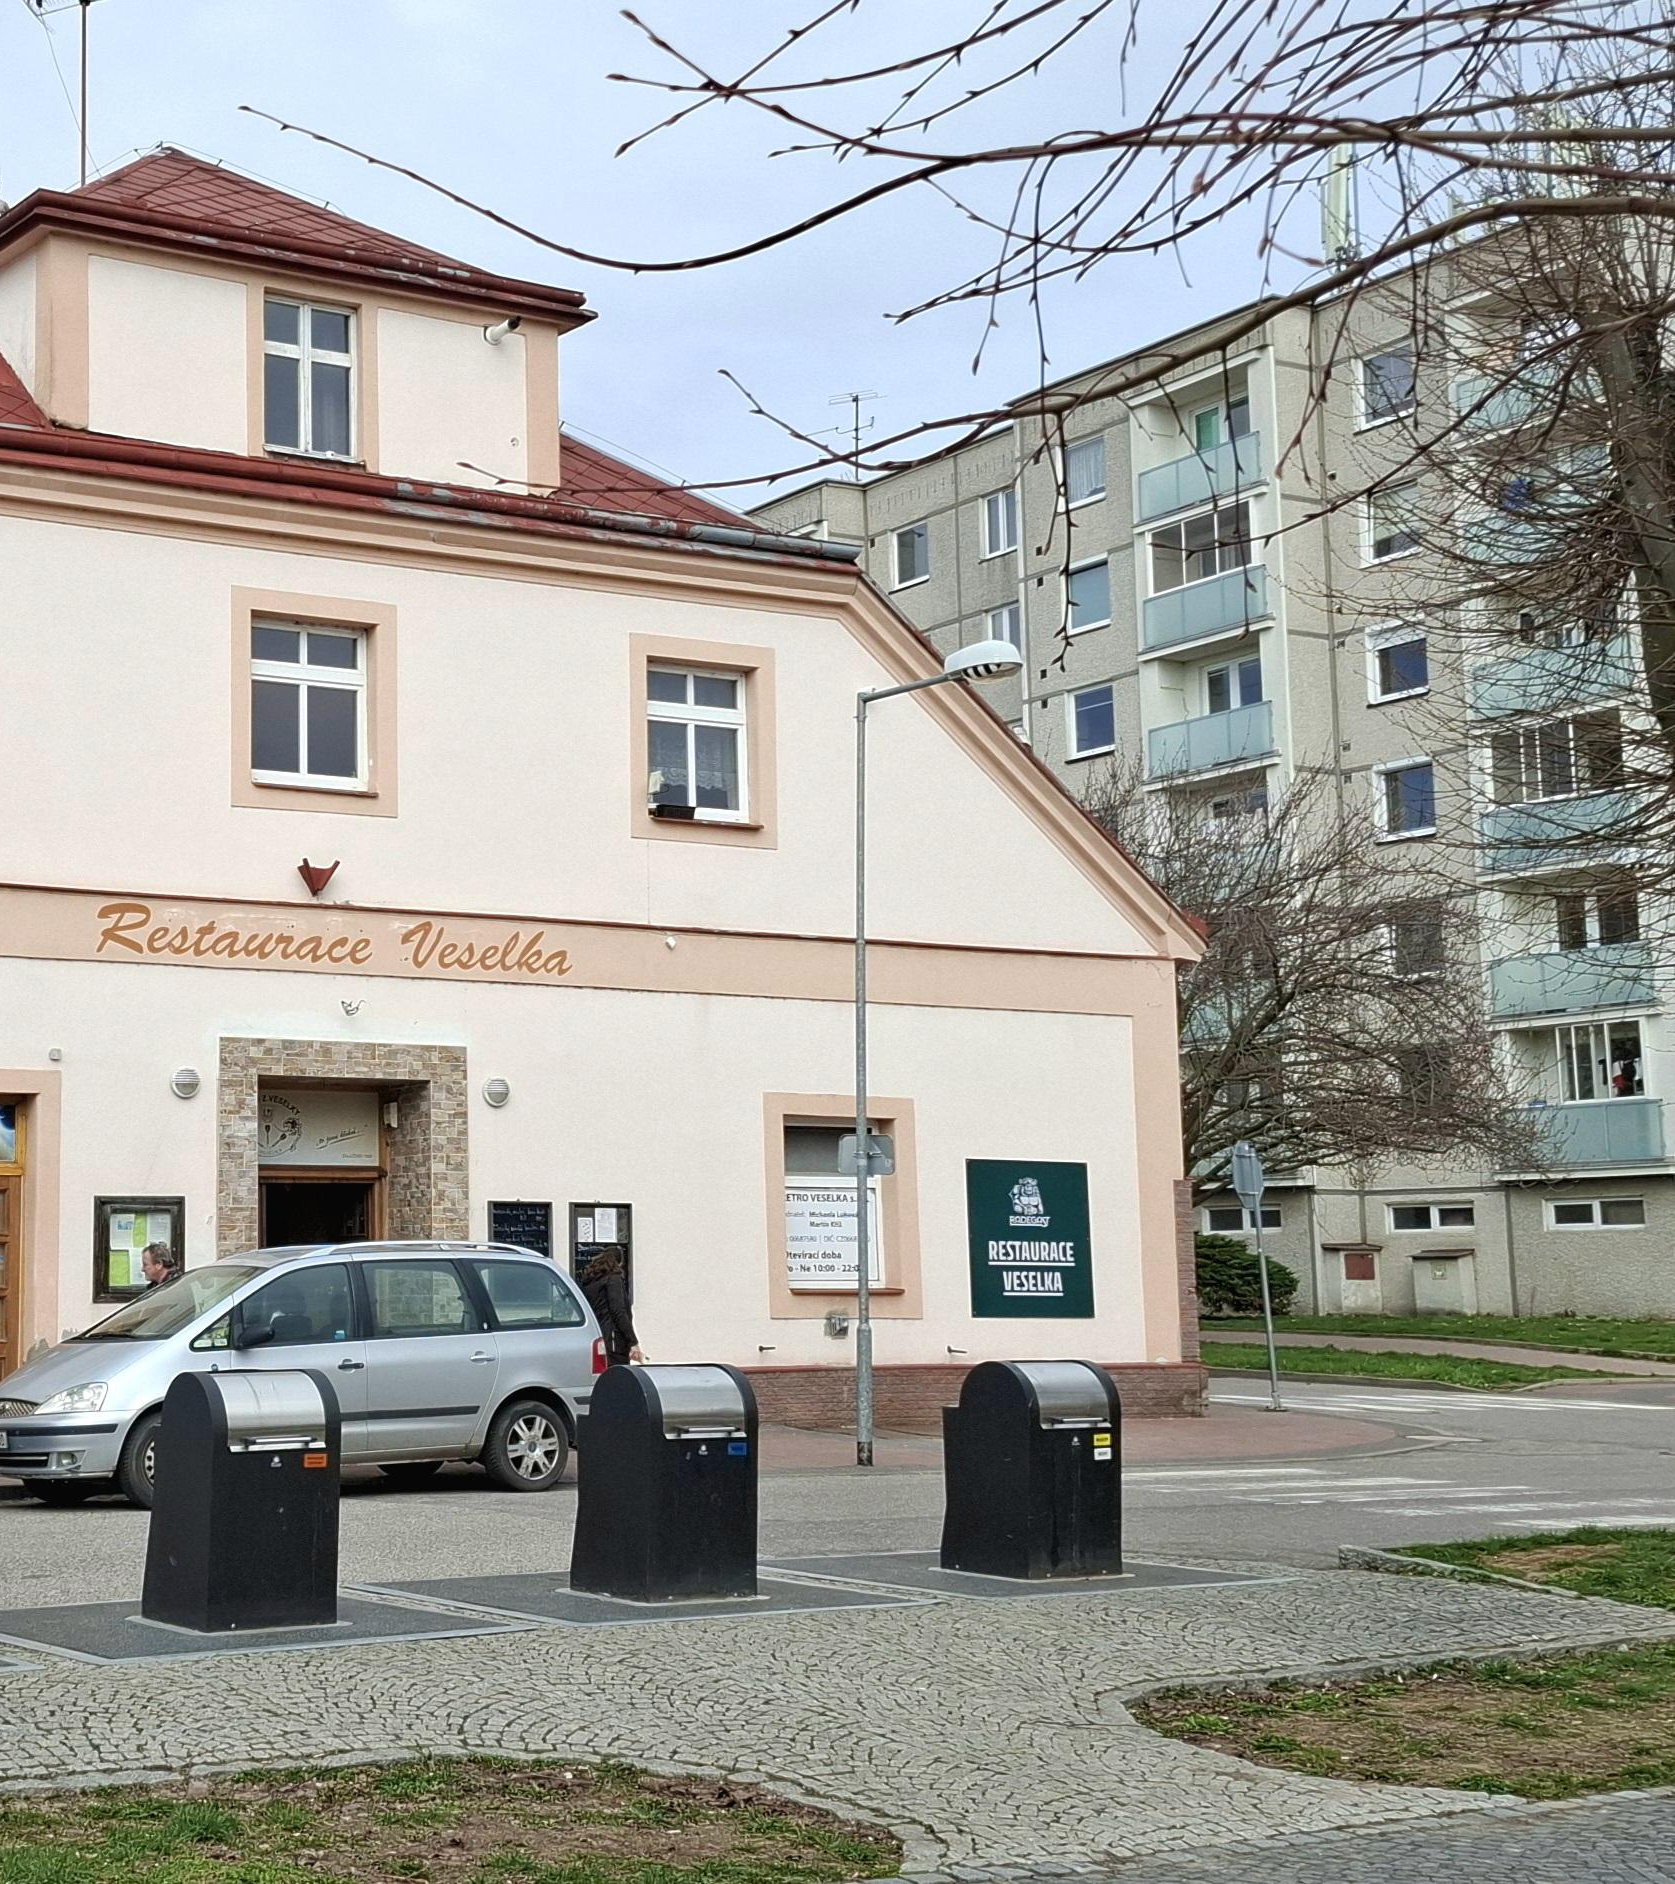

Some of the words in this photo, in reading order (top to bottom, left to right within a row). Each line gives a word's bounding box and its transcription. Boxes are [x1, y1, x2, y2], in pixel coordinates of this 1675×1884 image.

[95, 902, 373, 965] Restaurace
[401, 920, 573, 977] Veselka
[810, 1194, 849, 1202] VESELKA
[821, 1251, 842, 1260] doba
[988, 1241, 1075, 1261] RESTAURACE
[800, 1264, 811, 1272] Ne
[814, 1264, 835, 1272] 10:00
[842, 1264, 861, 1272] 22:0
[1003, 1272, 1063, 1291] VESELKA
